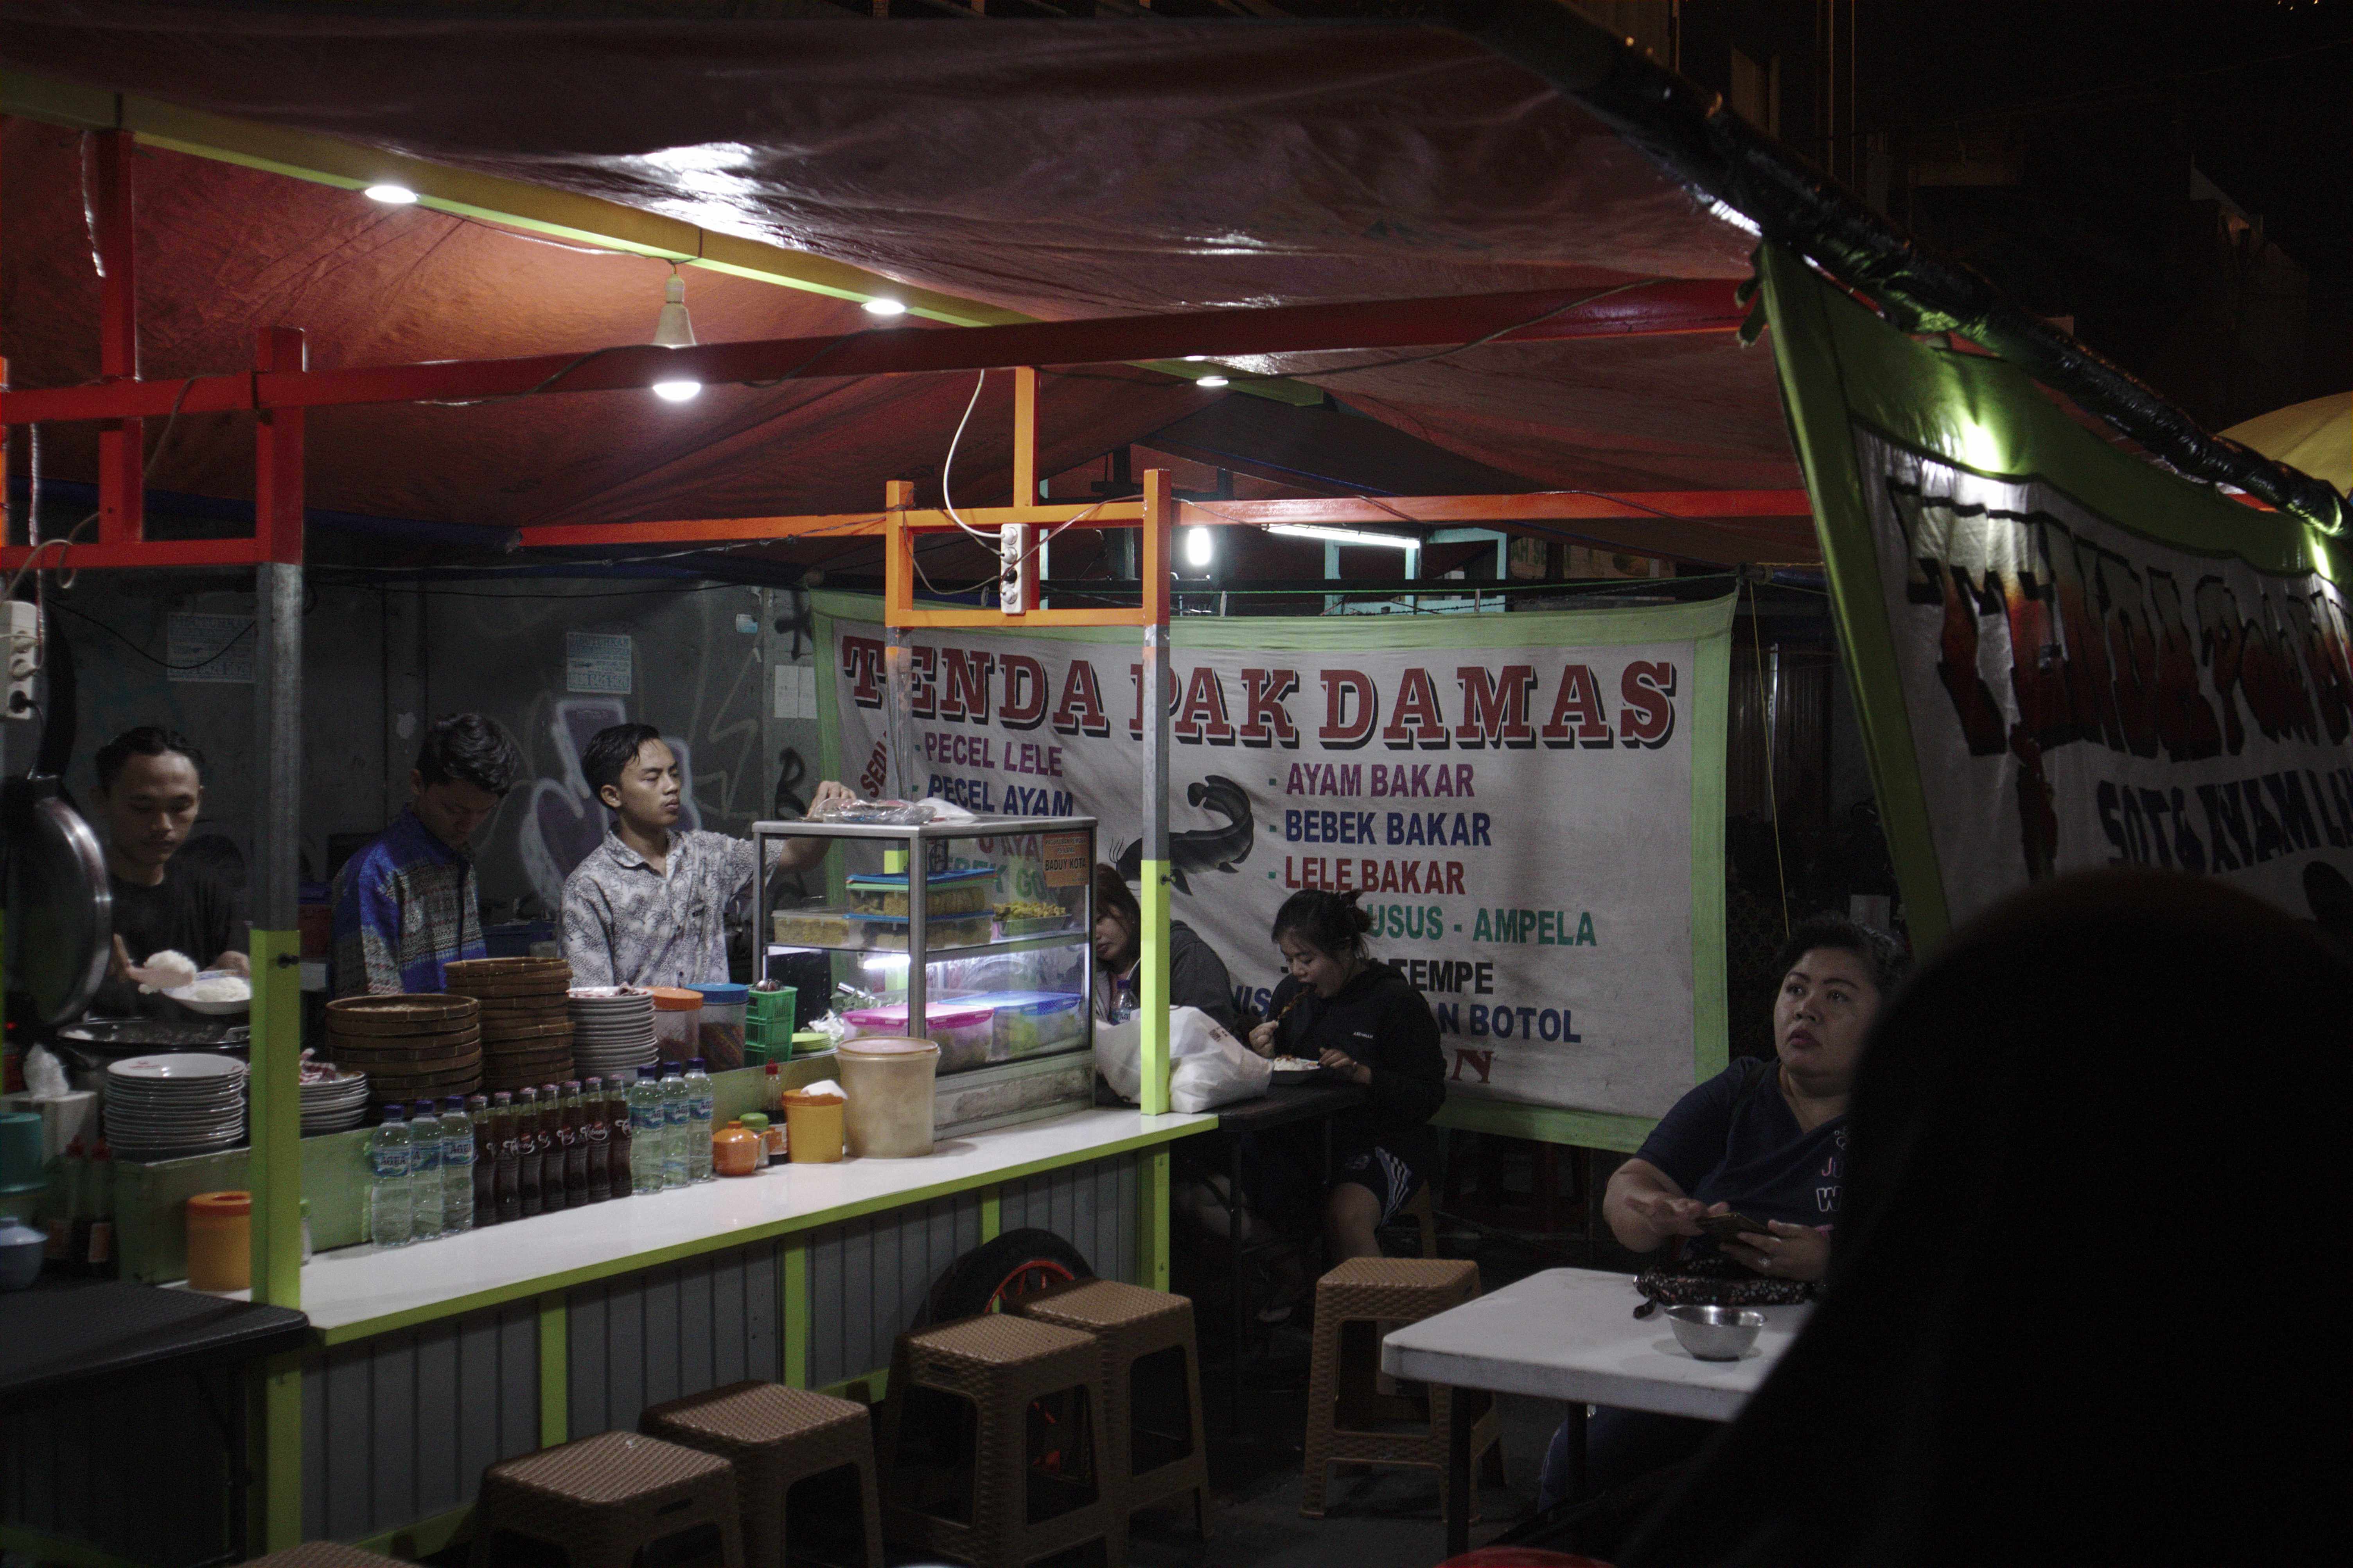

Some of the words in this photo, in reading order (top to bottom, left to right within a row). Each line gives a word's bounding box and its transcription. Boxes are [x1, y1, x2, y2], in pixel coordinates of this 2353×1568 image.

[842, 635, 1110, 737] TENDA
[1319, 661, 1676, 749] DAMAS
[925, 732, 995, 769] PECEL
[1004, 742, 1063, 777] LELE
[927, 774, 995, 812] PECEL
[1003, 786, 1073, 816] AYAM
[1286, 763, 1361, 796] AYAM
[1370, 764, 1475, 797] BAKAR
[1285, 809, 1376, 845] BEBEK
[1387, 813, 1491, 846] BAKAR
[1045, 859, 1067, 871] BADUY
[1069, 858, 1086, 868] KOTA
[1285, 856, 1352, 891] LELE
[1361, 859, 1466, 894] BAKAR
[1367, 904, 1444, 940] USUS
[1473, 908, 1597, 946] AMPELA
[1469, 1004, 1581, 1043] BOTOL
